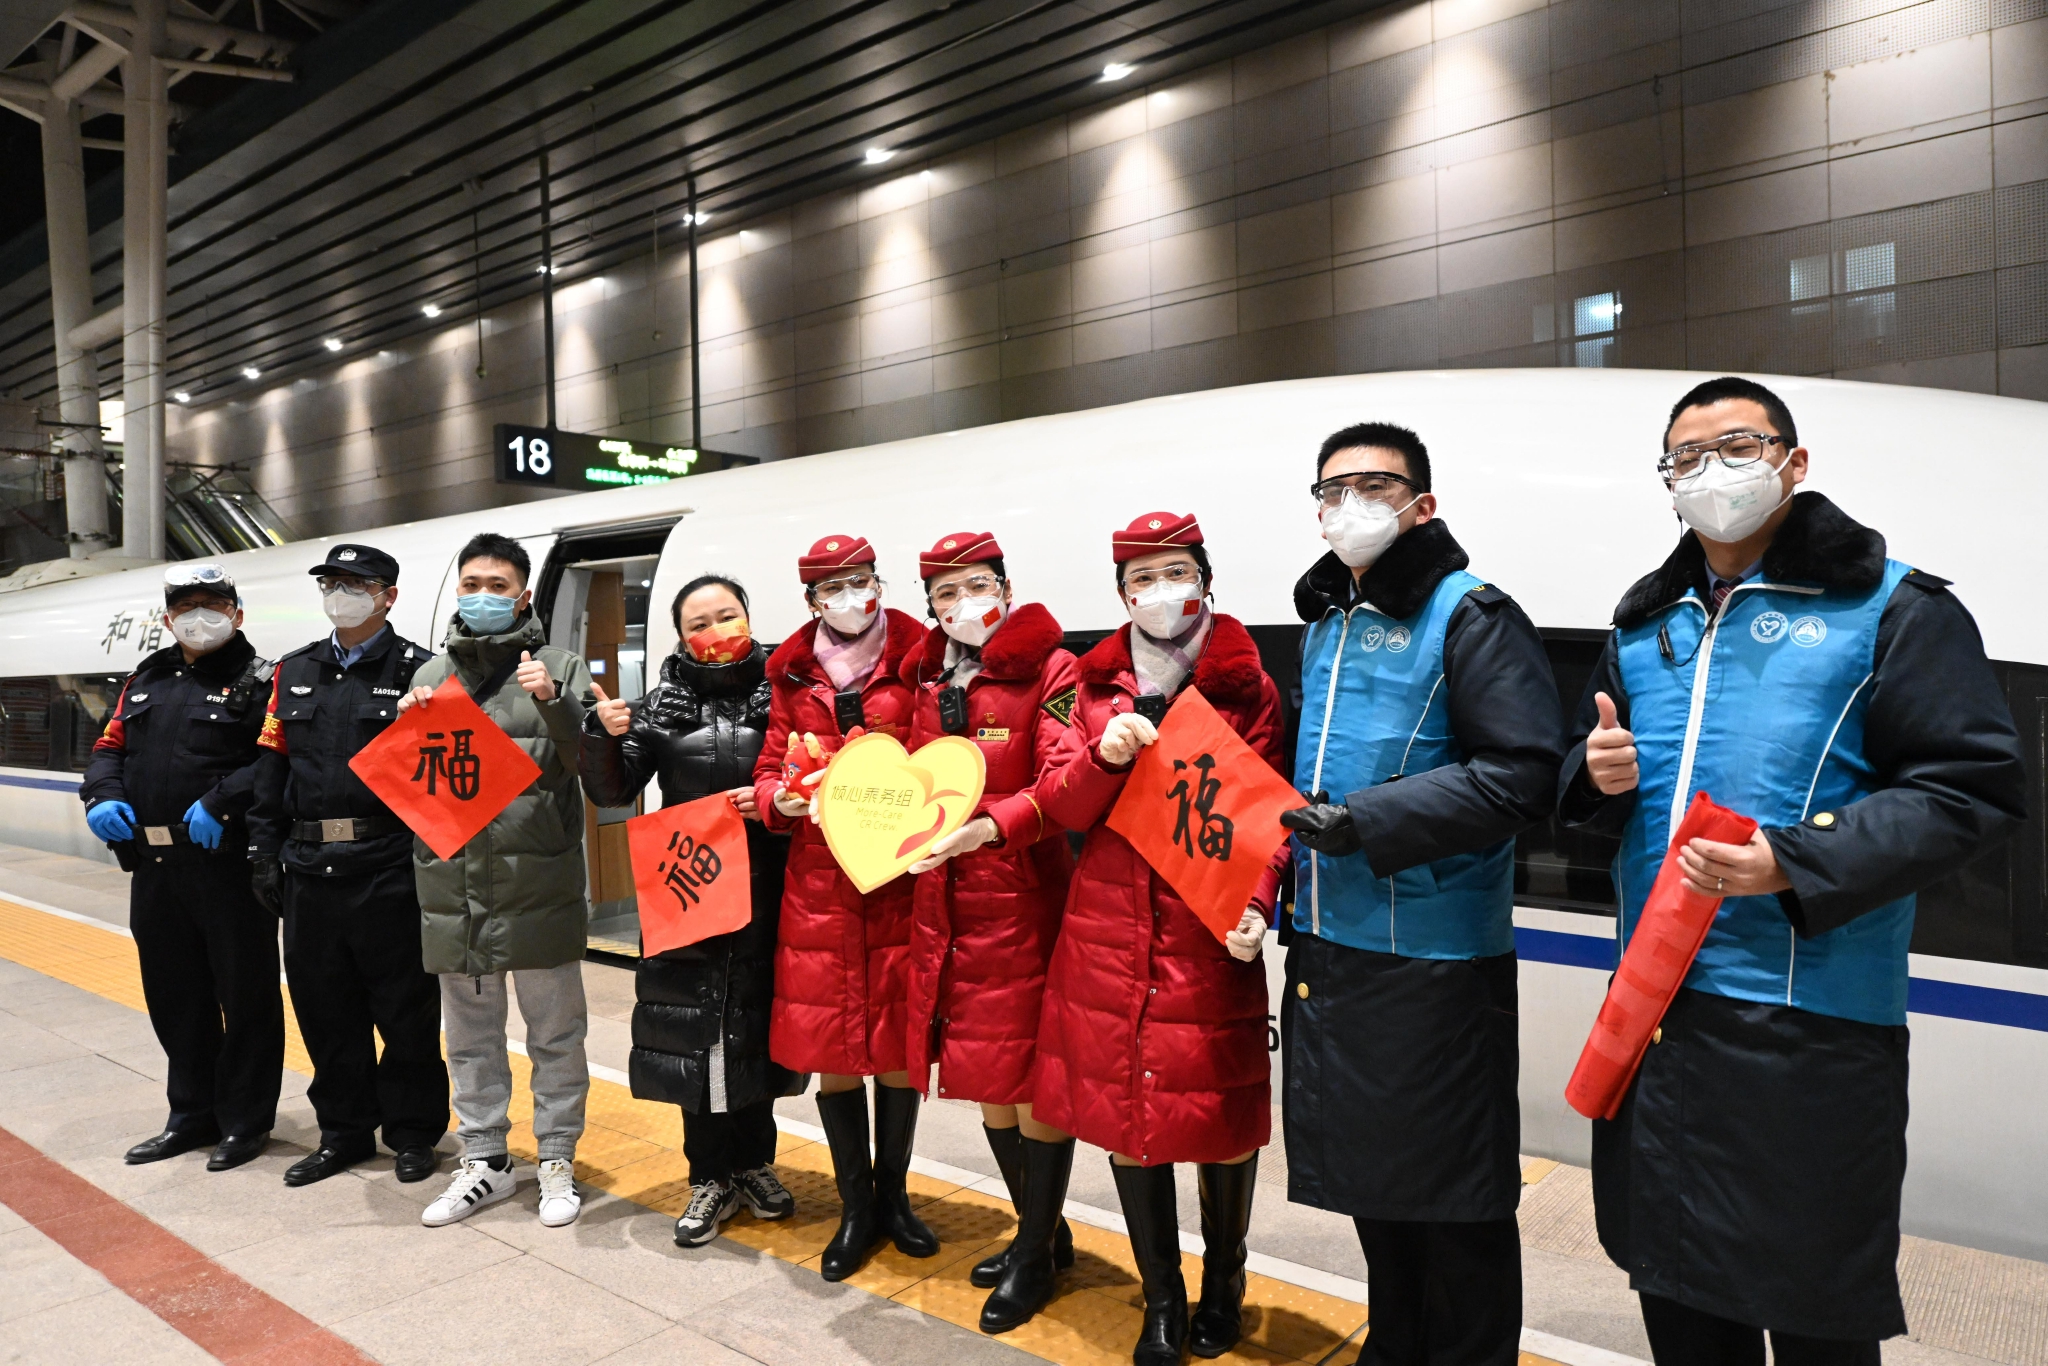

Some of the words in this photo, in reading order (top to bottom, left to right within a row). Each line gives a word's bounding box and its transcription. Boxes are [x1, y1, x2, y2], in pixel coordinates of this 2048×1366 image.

[508, 436, 552, 475] 18
[410, 729, 481, 801] 福
[831, 785, 914, 807] 倾心乘务组
[856, 807, 903, 820] More-Care
[1166, 753, 1235, 862] 福
[859, 819, 872, 829] CR
[657, 830, 723, 913] 福
